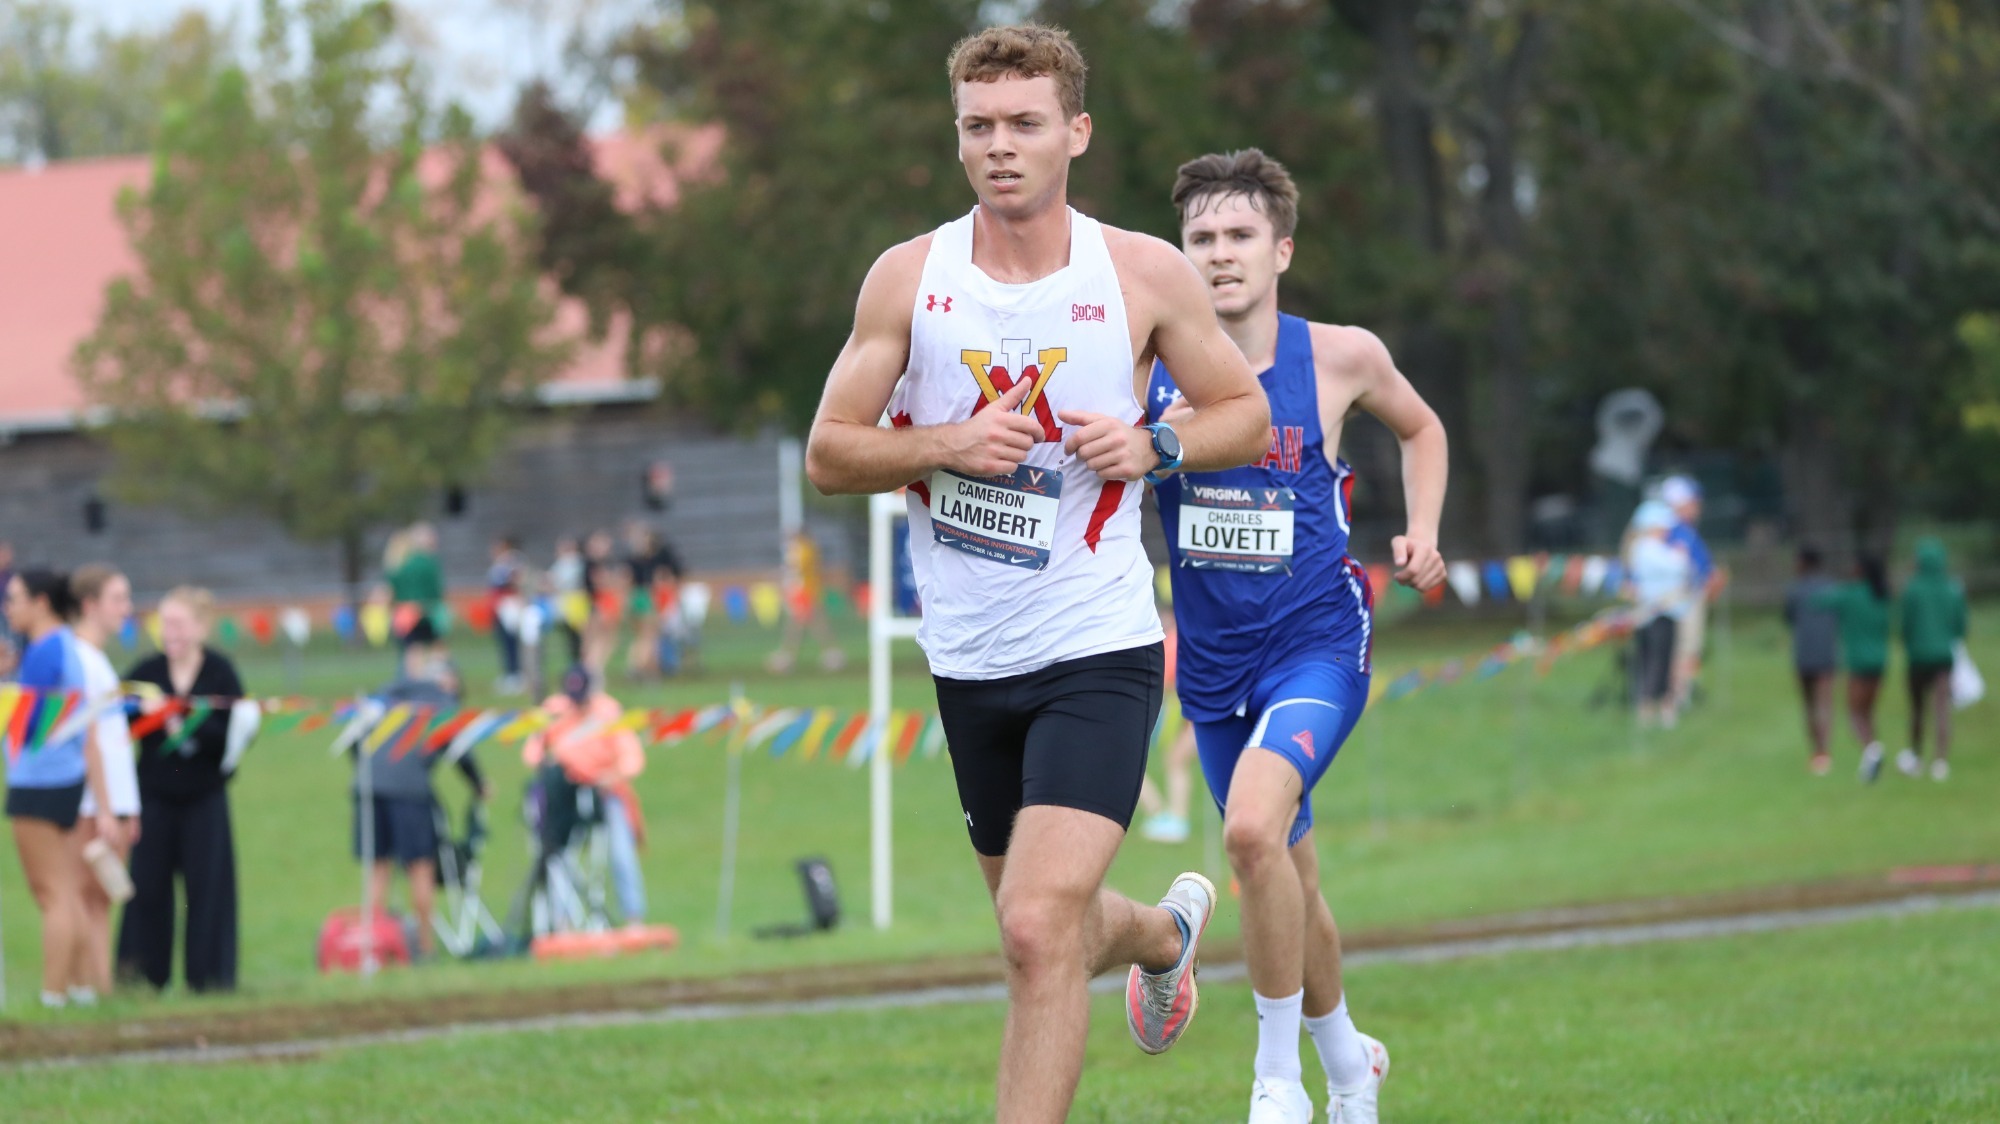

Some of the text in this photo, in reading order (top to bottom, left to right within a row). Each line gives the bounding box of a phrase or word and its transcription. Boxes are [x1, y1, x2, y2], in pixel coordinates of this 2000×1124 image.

[958, 481, 1025, 509] CAMERON
[1193, 485, 1252, 502] VIRGINIA
[940, 495, 1041, 539] LAMBERT
[1208, 511, 1263, 526] CHARLES
[936, 522, 1039, 557] PANORAMA FARMS INVITATIONAL
[961, 542, 986, 555] OCTOBER
[1038, 539, 1048, 547] 352
[1191, 524, 1280, 551] LOVETT
